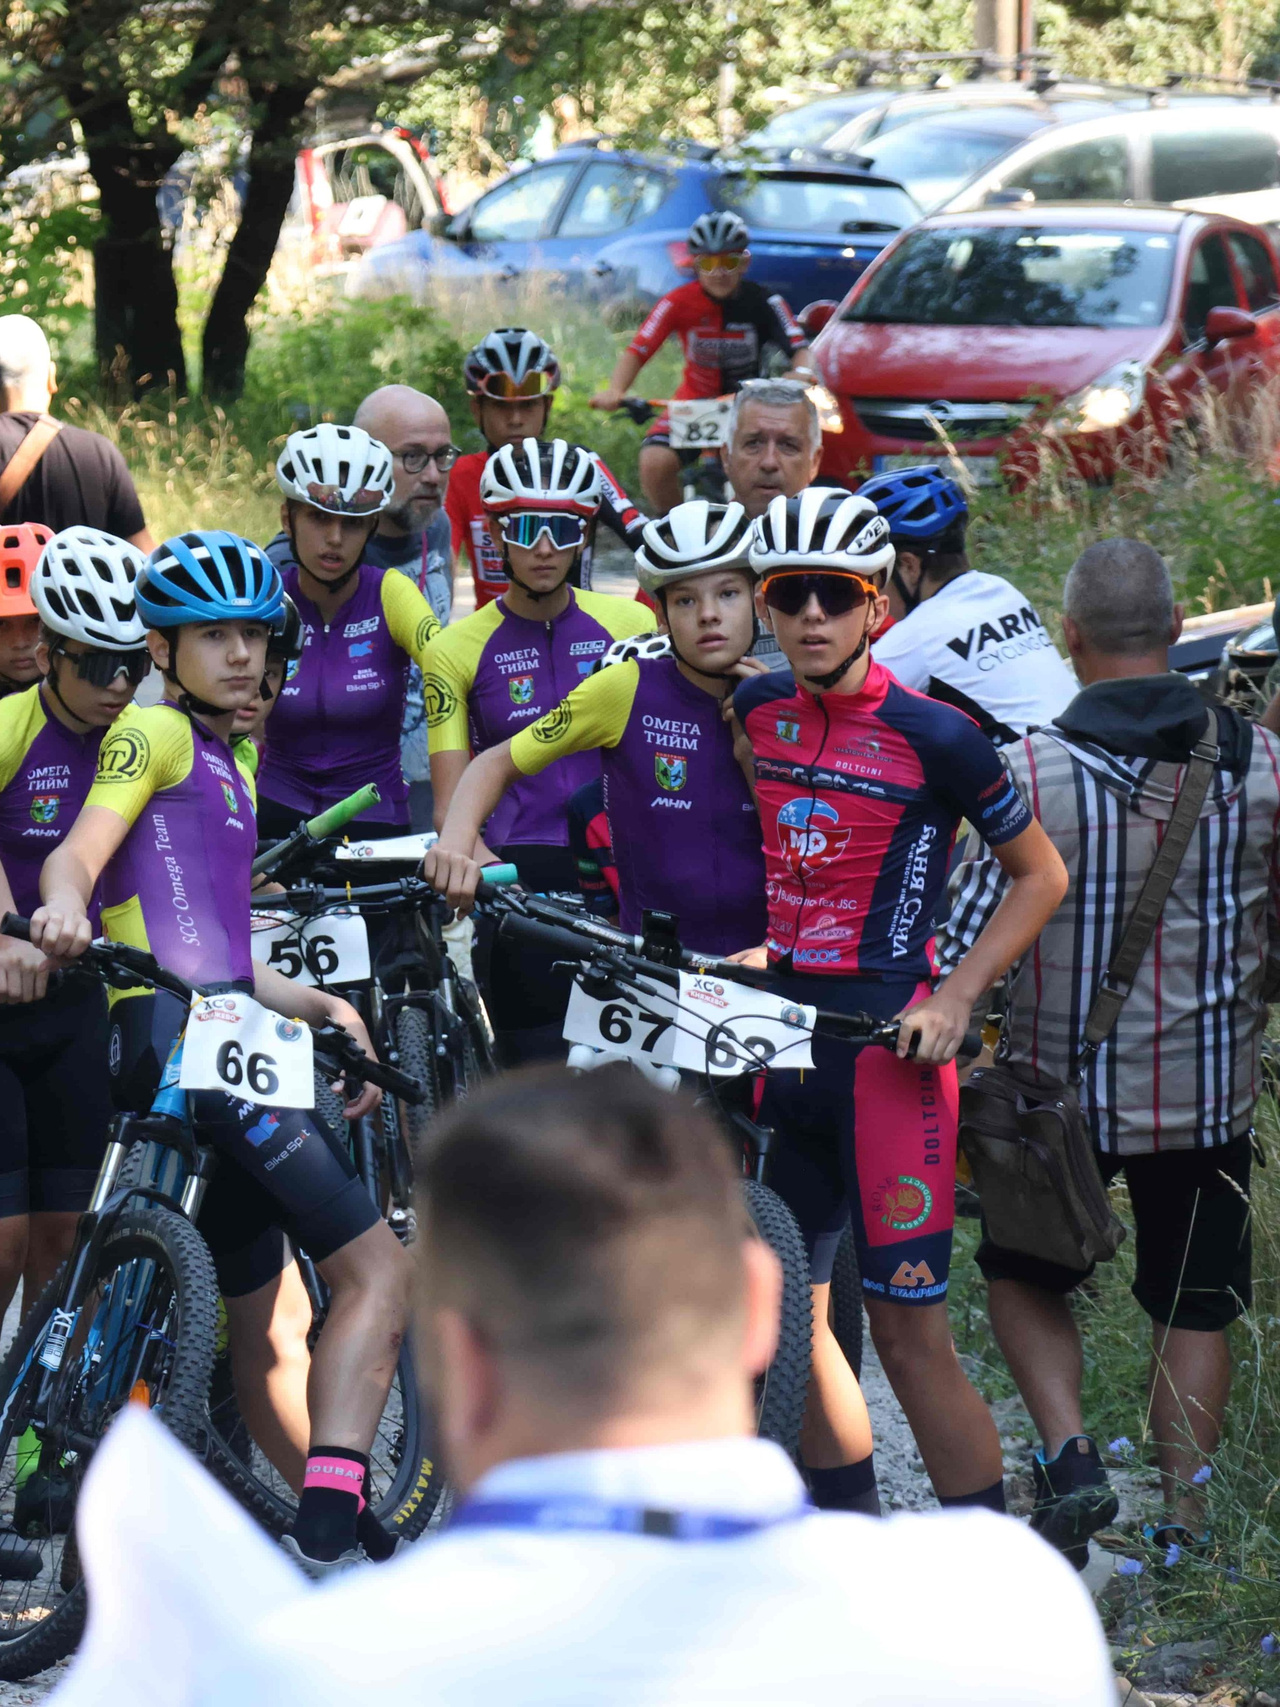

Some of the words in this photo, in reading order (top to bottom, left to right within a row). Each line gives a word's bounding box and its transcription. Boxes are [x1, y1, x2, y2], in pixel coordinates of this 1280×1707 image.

[687, 422, 719, 441] 82
[855, 518, 884, 549] MET
[946, 606, 1041, 661] VARN
[494, 647, 540, 664] ОМЕГА
[498, 659, 540, 675] ТИЙМ
[642, 715, 702, 736] ОМЕГА
[644, 730, 699, 751] ТИЙМ
[27, 765, 71, 780] ОМЕГА
[835, 760, 883, 777] DOLTCINI
[152, 814, 172, 851] Team
[165, 856, 190, 911] Omega
[837, 899, 858, 910] JSC
[177, 914, 200, 946] SCC
[269, 935, 340, 979] 56
[599, 1003, 674, 1053] 67
[705, 1024, 776, 1071] 62
[216, 1039, 280, 1096] 66
[921, 1070, 940, 1165] DOLTCIN
[264, 1150, 290, 1171] Bike
[393, 1458, 434, 1524] MAXXIS
